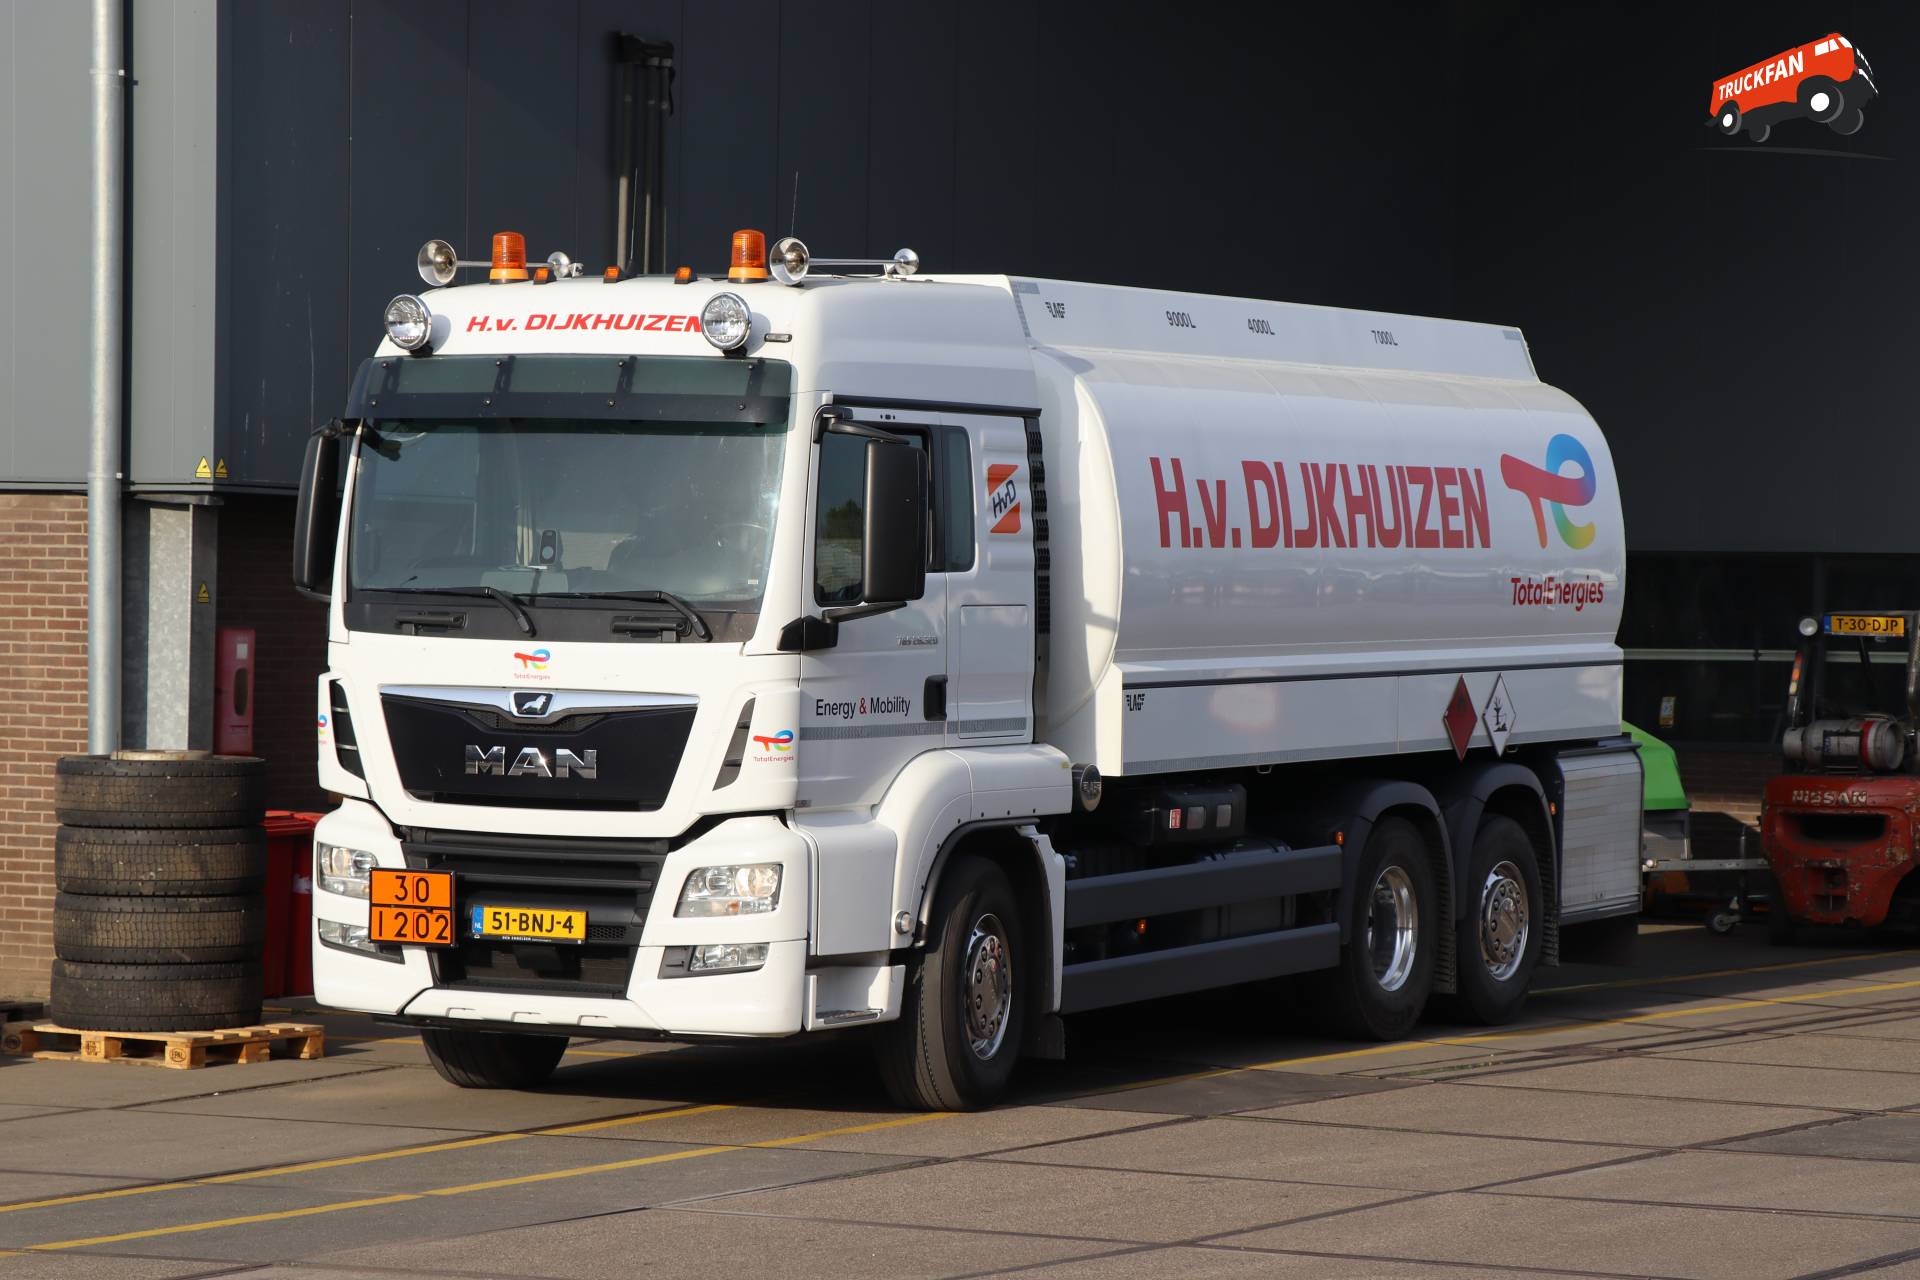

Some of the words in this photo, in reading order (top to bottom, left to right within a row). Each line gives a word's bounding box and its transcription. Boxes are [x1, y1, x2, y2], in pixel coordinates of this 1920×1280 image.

[466, 316, 517, 333] H.v.
[1165, 310, 1197, 329] 9000L
[1247, 318, 1276, 336] 4000L
[1370, 329, 1399, 347] 7000L
[1149, 456, 1242, 549] H.v.
[1241, 459, 1491, 549] DIJKHUIZEN
[1511, 574, 1605, 612] TotalEnergies
[1836, 617, 1899, 632] T-30-DJP
[815, 698, 857, 720] Energy
[859, 696, 868, 715] &
[870, 695, 911, 718] Mobility
[464, 744, 597, 780] MAN
[1792, 789, 1868, 805] NISSAN
[394, 875, 430, 903] 30
[378, 910, 449, 941] 1202
[491, 911, 575, 935] 51-BNJ-4
